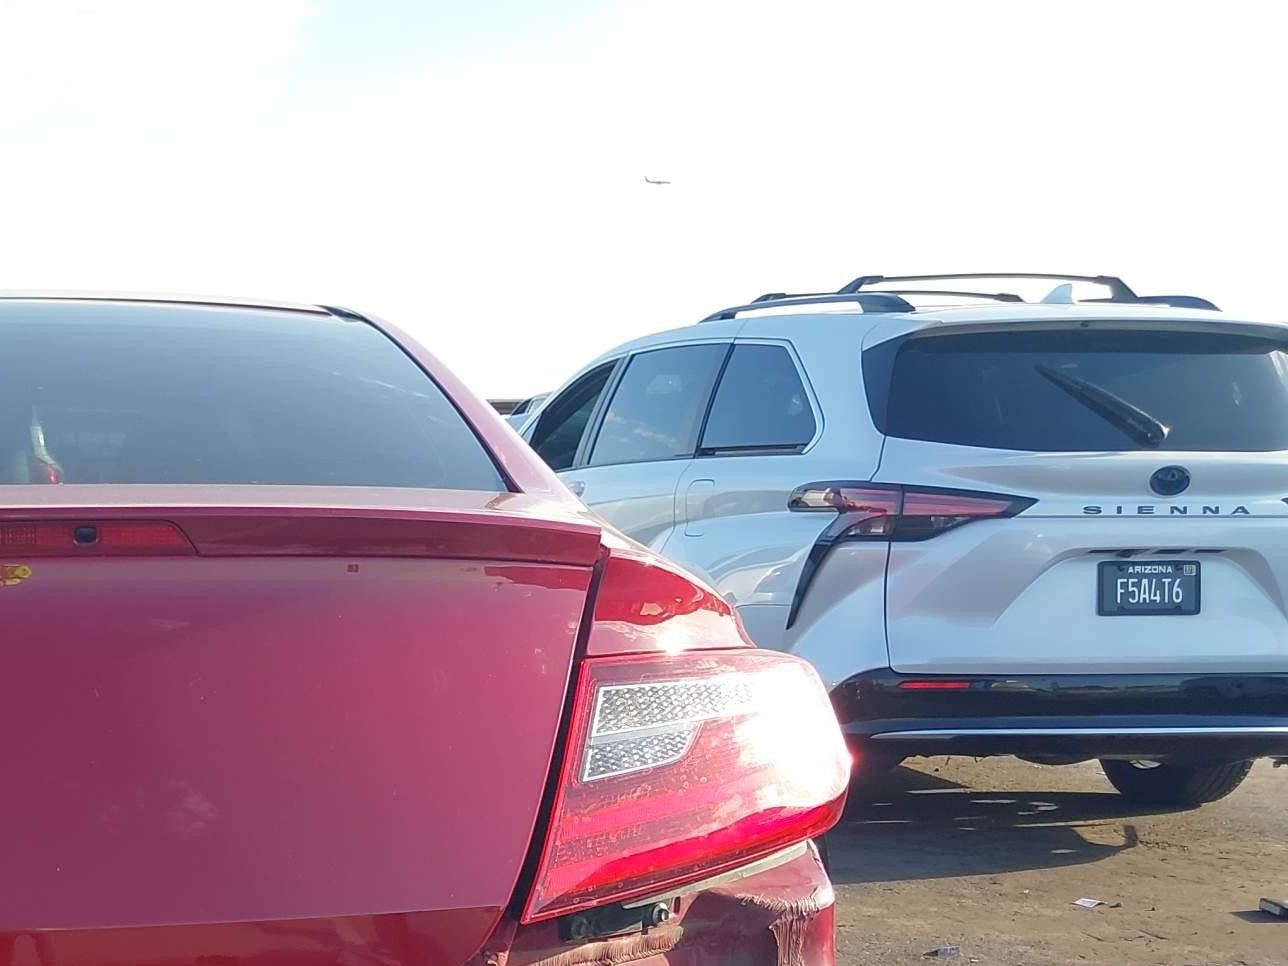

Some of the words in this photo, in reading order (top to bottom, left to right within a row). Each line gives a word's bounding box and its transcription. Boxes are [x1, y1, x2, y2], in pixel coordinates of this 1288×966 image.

[1082, 505, 1250, 515] SIENNA
[1127, 565, 1173, 574] ARIZONA
[1116, 578, 1183, 604] F5A4T6
